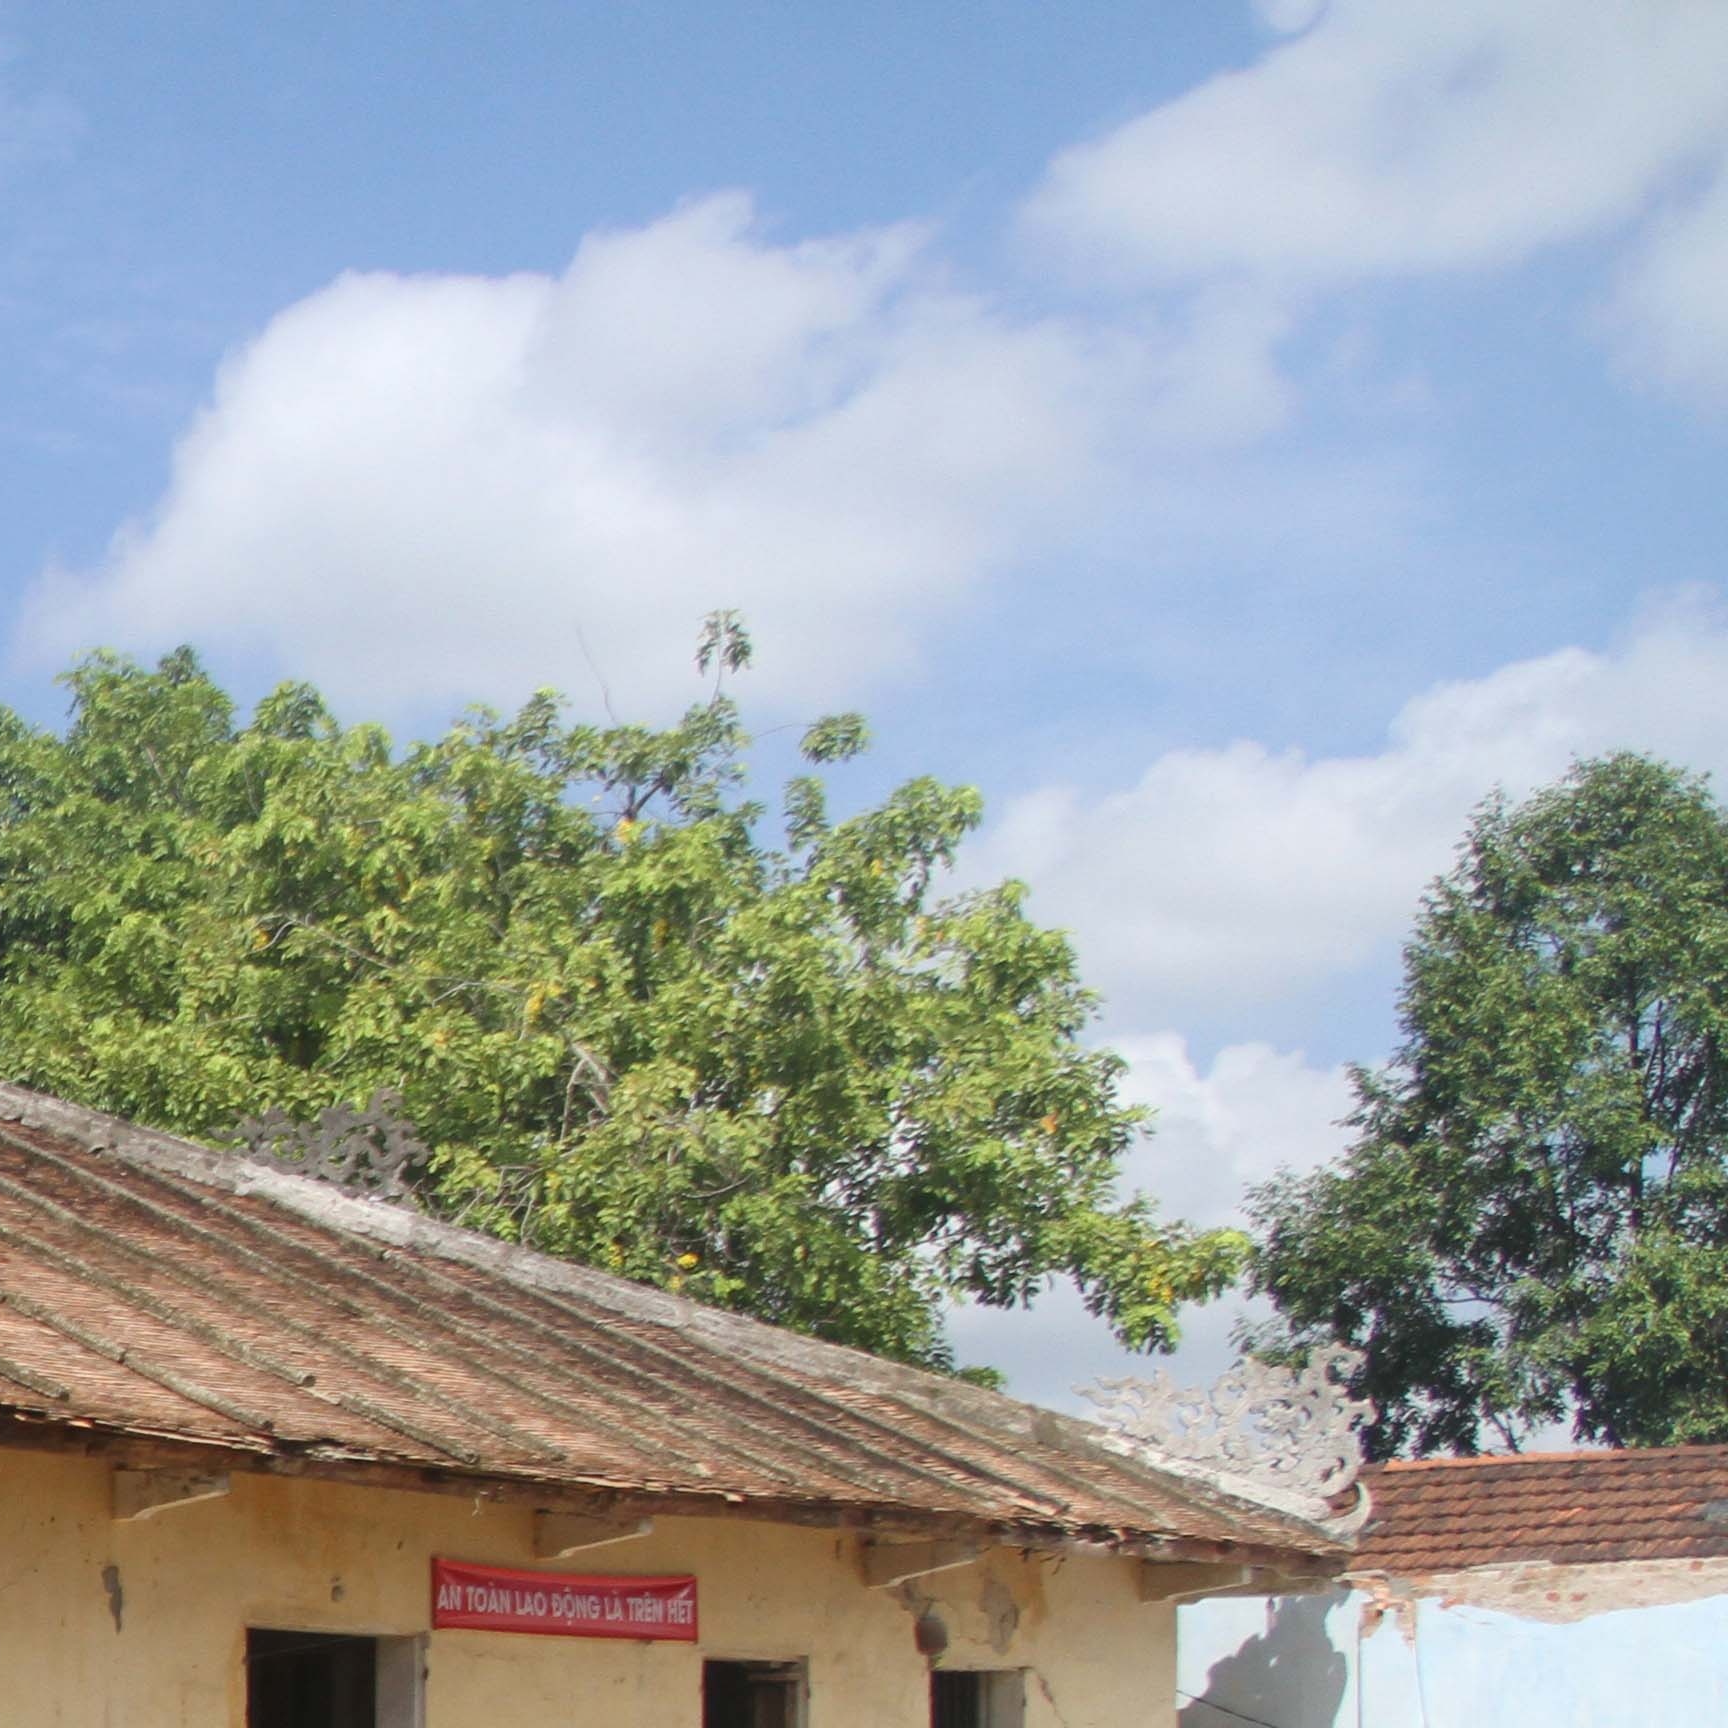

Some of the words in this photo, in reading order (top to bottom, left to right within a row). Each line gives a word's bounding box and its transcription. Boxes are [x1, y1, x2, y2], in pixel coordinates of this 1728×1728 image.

[437, 1583, 462, 1610] AN
[466, 1581, 511, 1614] TOÀN
[515, 1591, 547, 1617] LAO
[551, 1587, 600, 1626] ĐỘNG
[605, 1590, 624, 1621] LÀ
[628, 1591, 664, 1623] TRÊN
